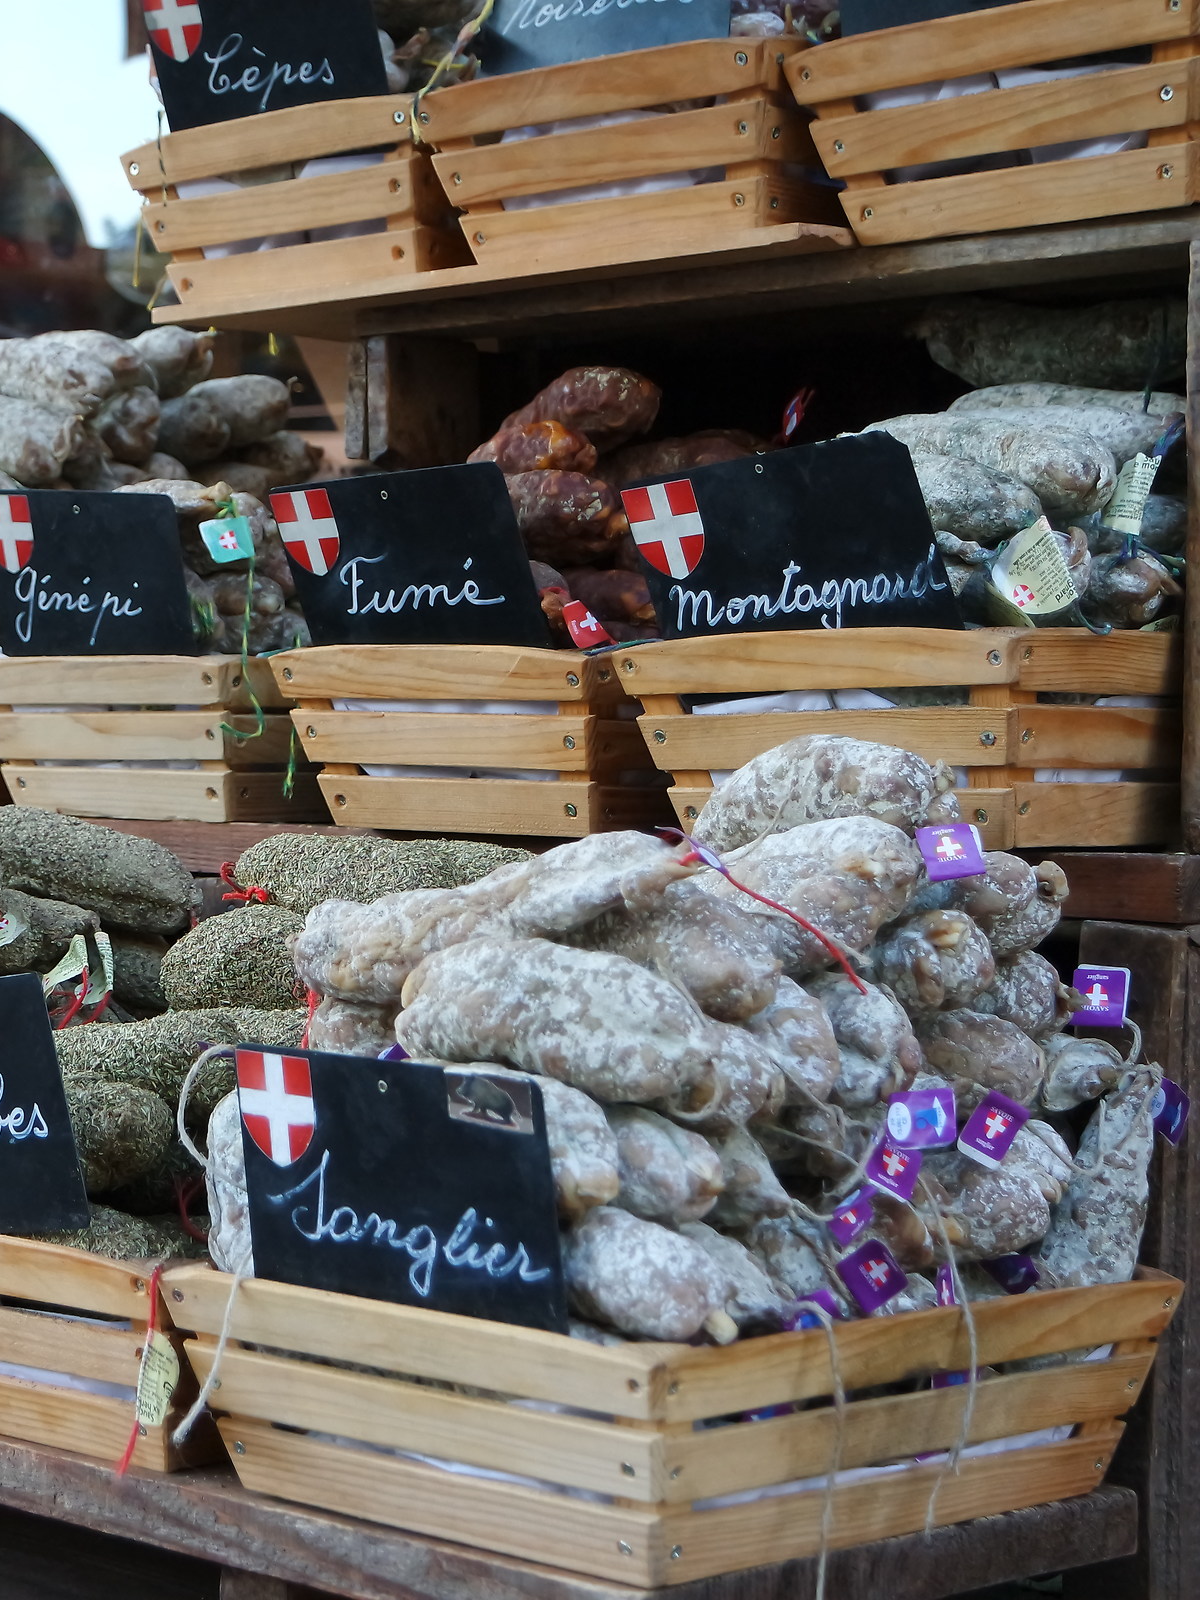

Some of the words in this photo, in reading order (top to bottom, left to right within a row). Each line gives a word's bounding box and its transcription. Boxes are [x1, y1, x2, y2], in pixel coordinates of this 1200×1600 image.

[203, 32, 335, 112] Cèpes
[340, 553, 505, 616] Fumé
[668, 542, 947, 631] Montagnard
[989, 1106, 1015, 1123] SAVOIE
[266, 1148, 551, 1297] Sanglier
